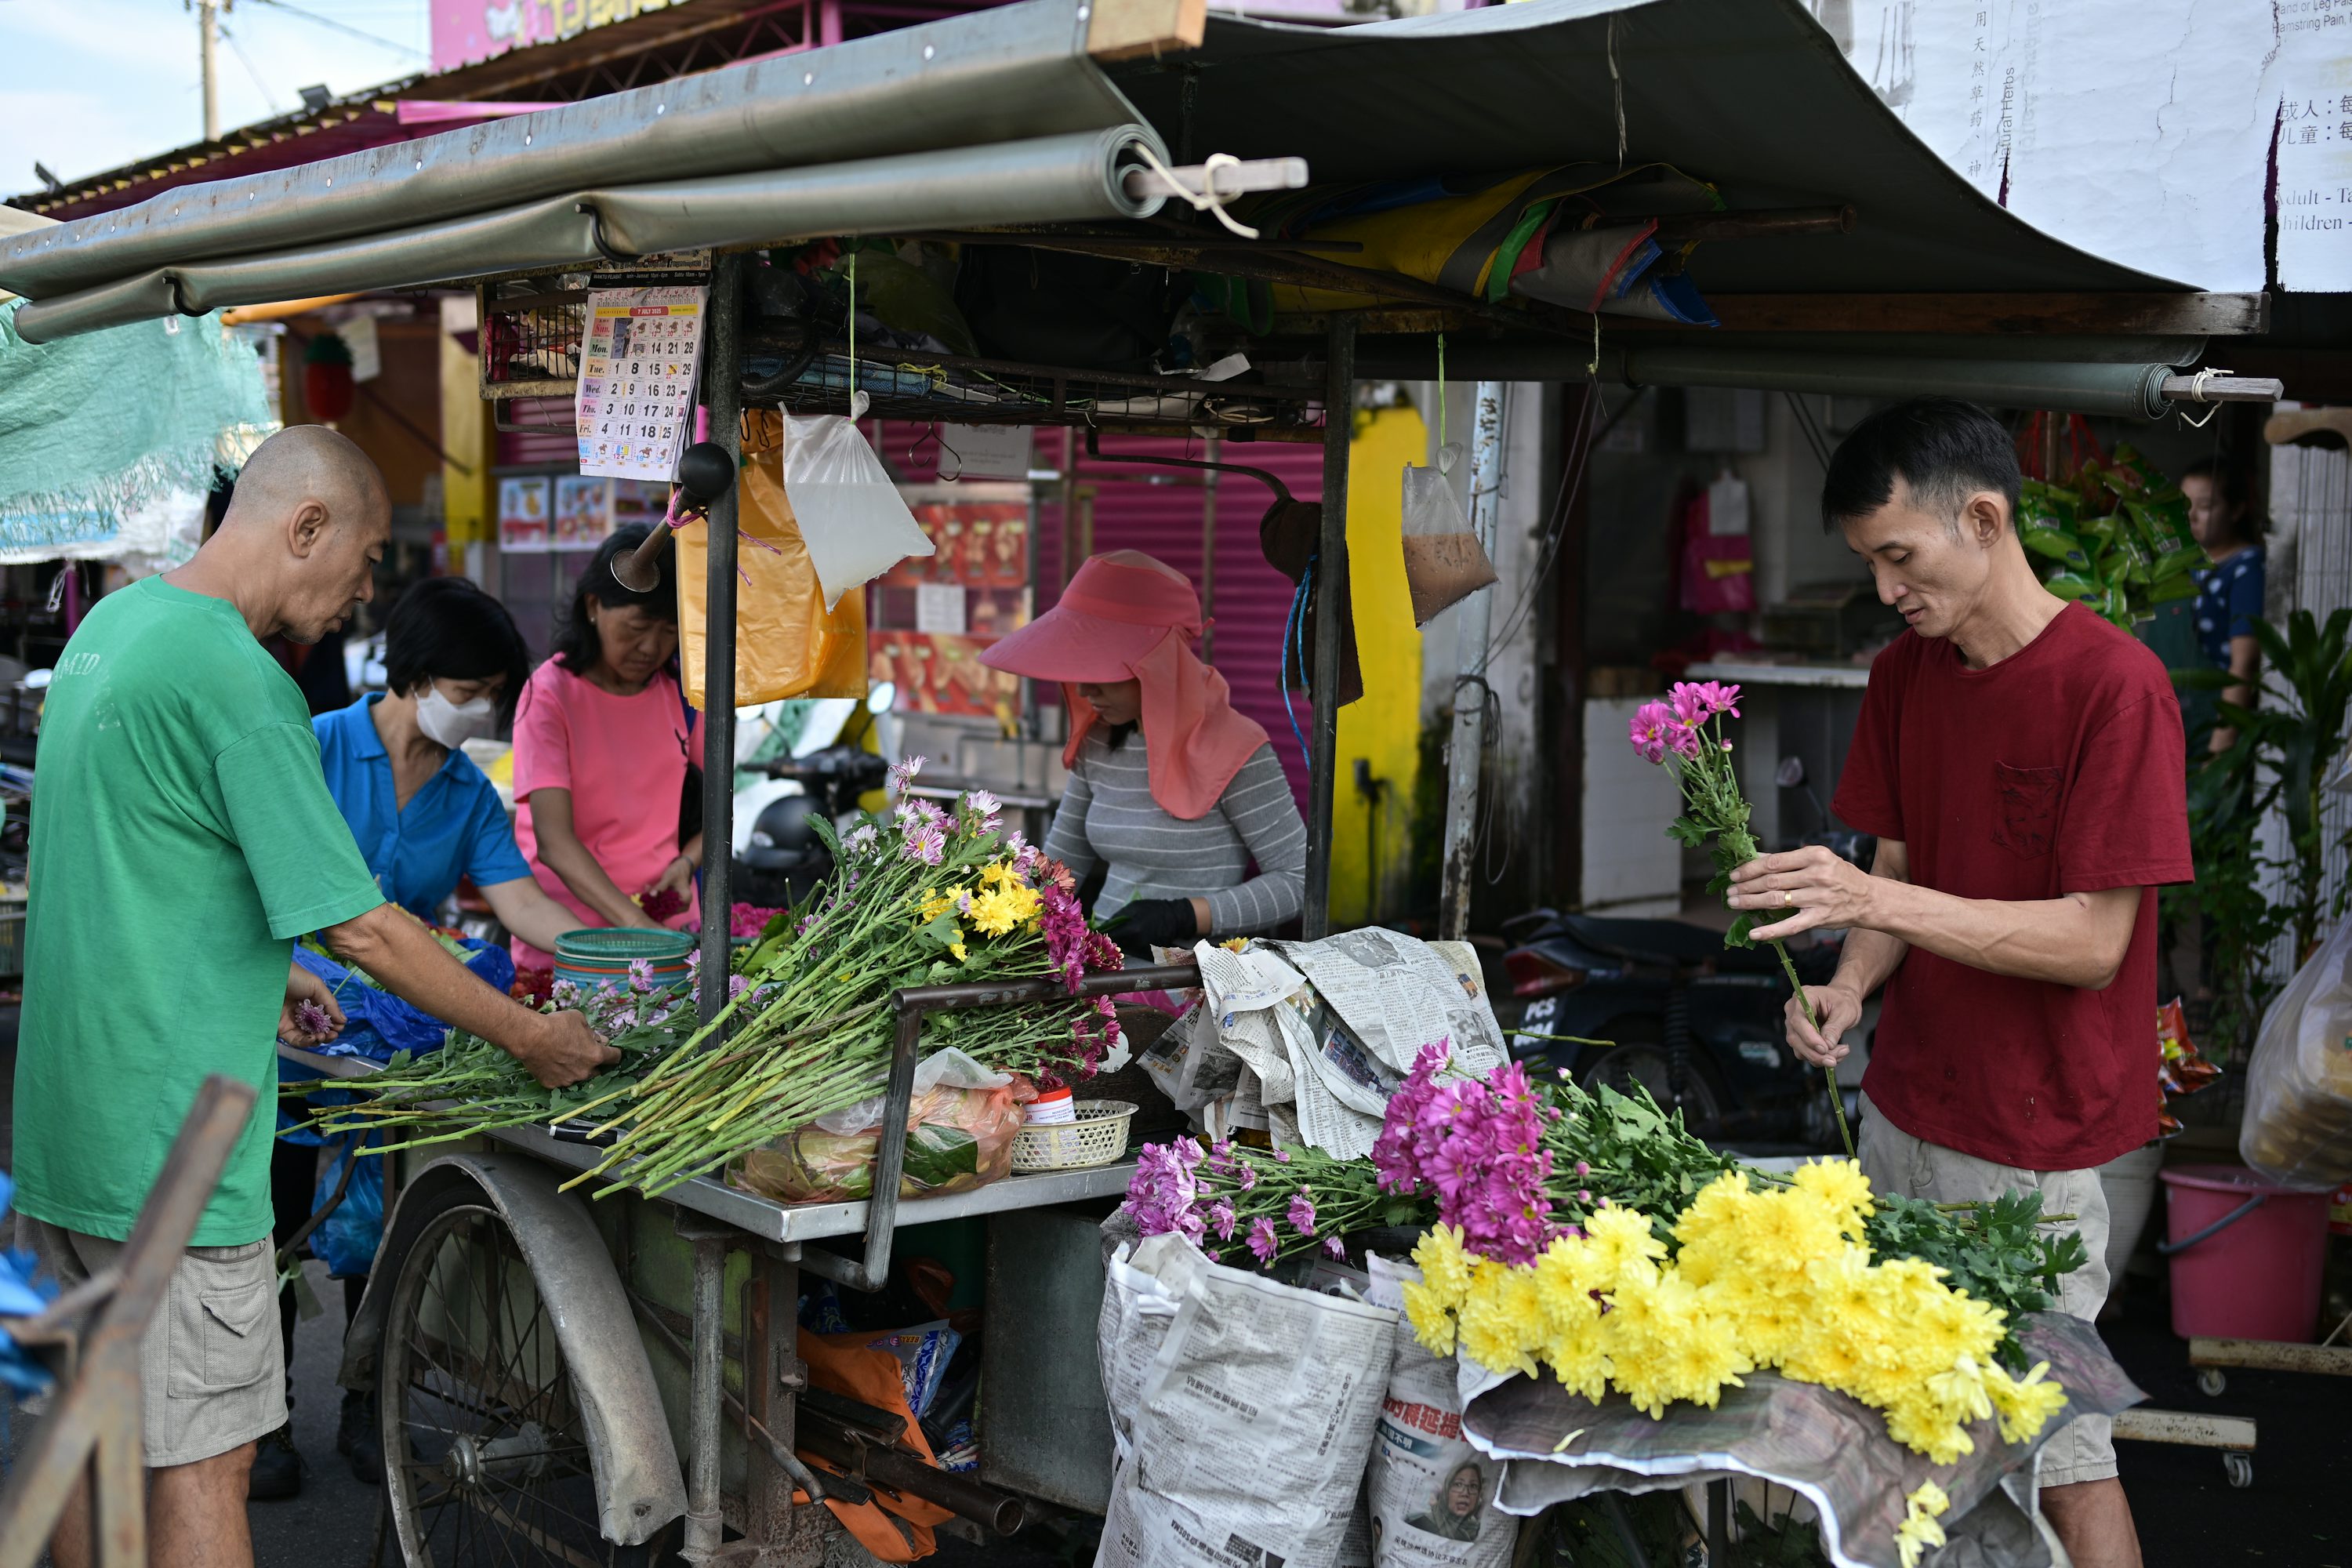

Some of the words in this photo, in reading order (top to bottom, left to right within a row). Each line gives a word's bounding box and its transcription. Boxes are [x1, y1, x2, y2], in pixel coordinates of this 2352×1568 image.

[2301, 2, 2310, 12] or
[2273, 19, 2321, 34] Hamstring
[2324, 15, 2347, 27] Pain,
[1968, 0, 1987, 178] 用天然草药、神
[2002, 67, 2015, 111] Herbs
[1998, 114, 2013, 168] Natural
[2279, 215, 2343, 231] hildren
[590, 344, 608, 354] Mon.
[652, 342, 661, 354] 14
[668, 342, 678, 354] 21
[684, 342, 694, 354] 28
[589, 364, 604, 374] Tue.
[615, 362, 619, 374] 1
[631, 362, 639, 375] 8
[649, 363, 660, 376] 15
[682, 363, 691, 376] 29
[586, 384, 601, 394] Wed.
[611, 383, 618, 394] 2
[629, 383, 635, 395] 9
[648, 384, 659, 397] 16
[666, 385, 676, 397] 23
[583, 405, 596, 413] Thu.
[606, 403, 614, 415] 3
[624, 404, 635, 416] 10
[644, 405, 659, 417] 17
[664, 406, 673, 418] 24
[579, 424, 591, 434] Fri.
[601, 423, 608, 434] 4
[620, 423, 631, 436] 11
[641, 425, 656, 438] 18
[662, 426, 672, 439] 25
[1525, 997, 1557, 1022] PCS
